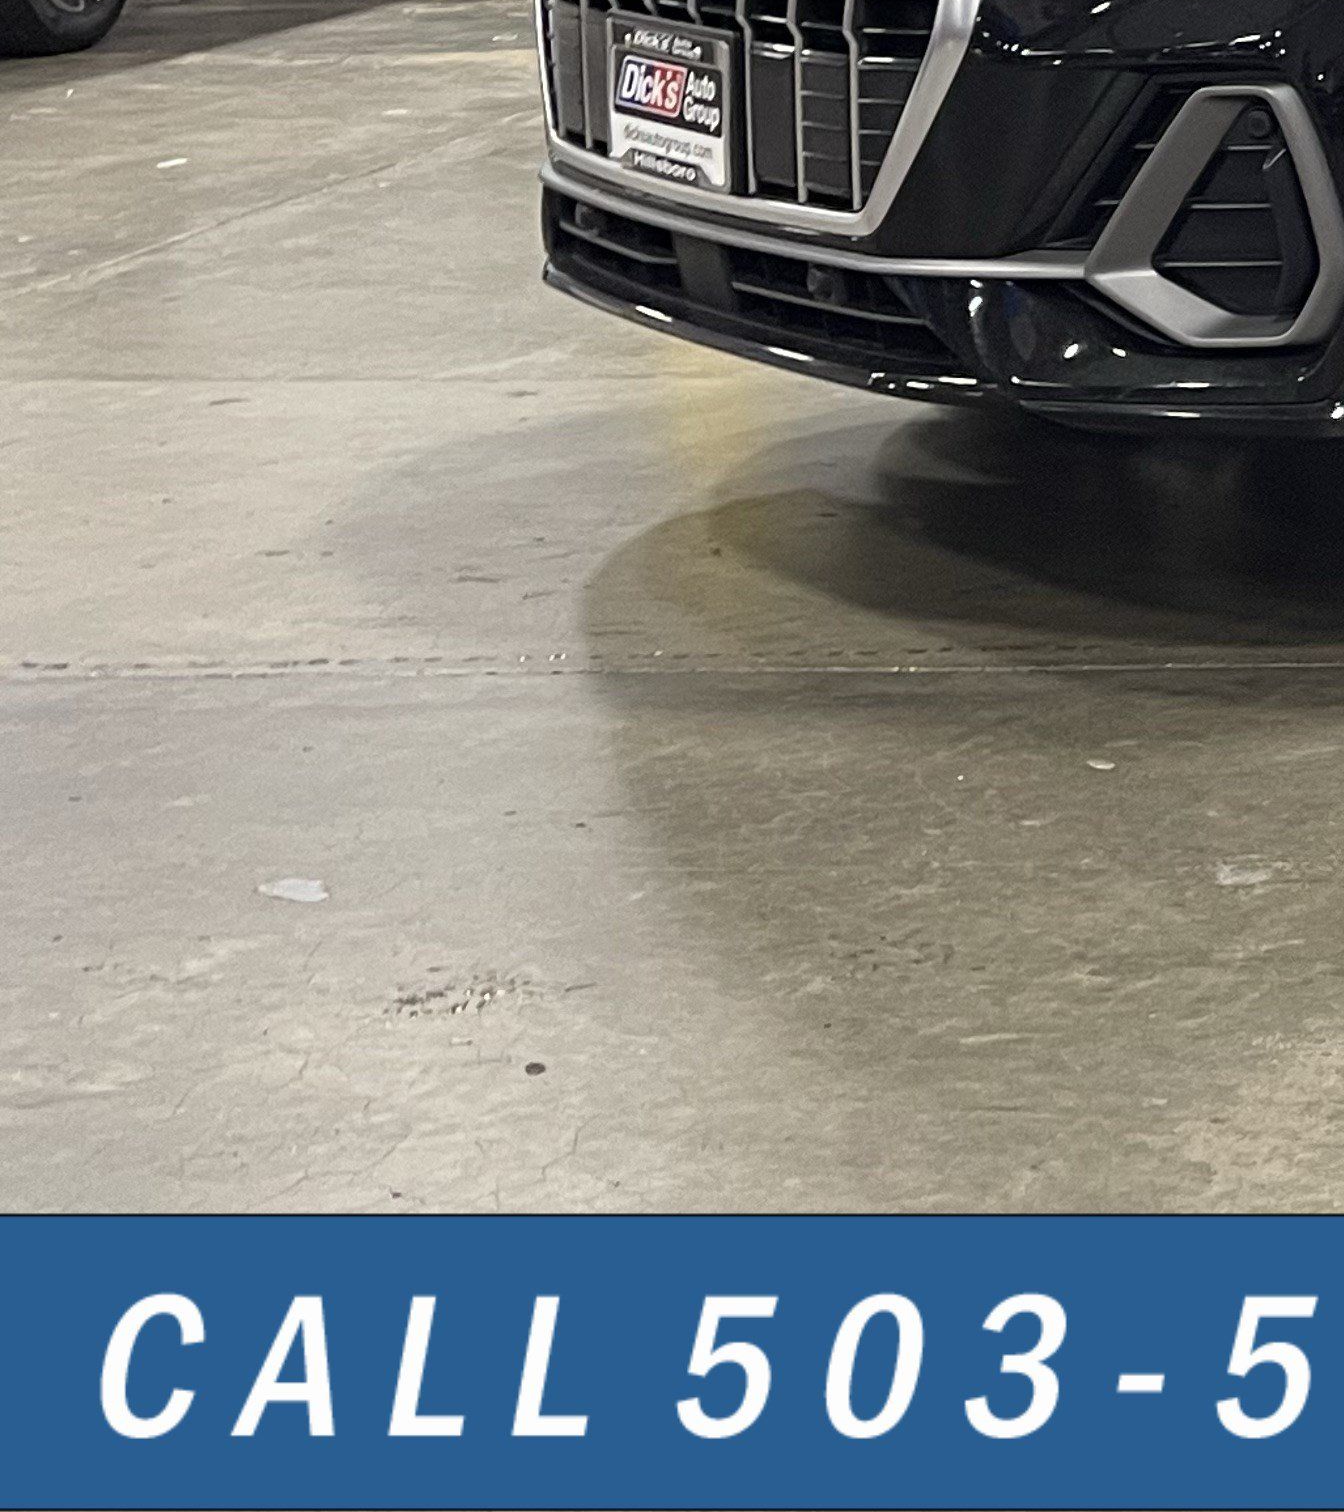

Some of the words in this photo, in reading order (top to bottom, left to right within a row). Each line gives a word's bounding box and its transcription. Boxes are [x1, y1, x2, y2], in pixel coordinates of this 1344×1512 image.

[621, 62, 681, 110] Dick's
[685, 70, 717, 102] Auto
[682, 95, 721, 133] Group
